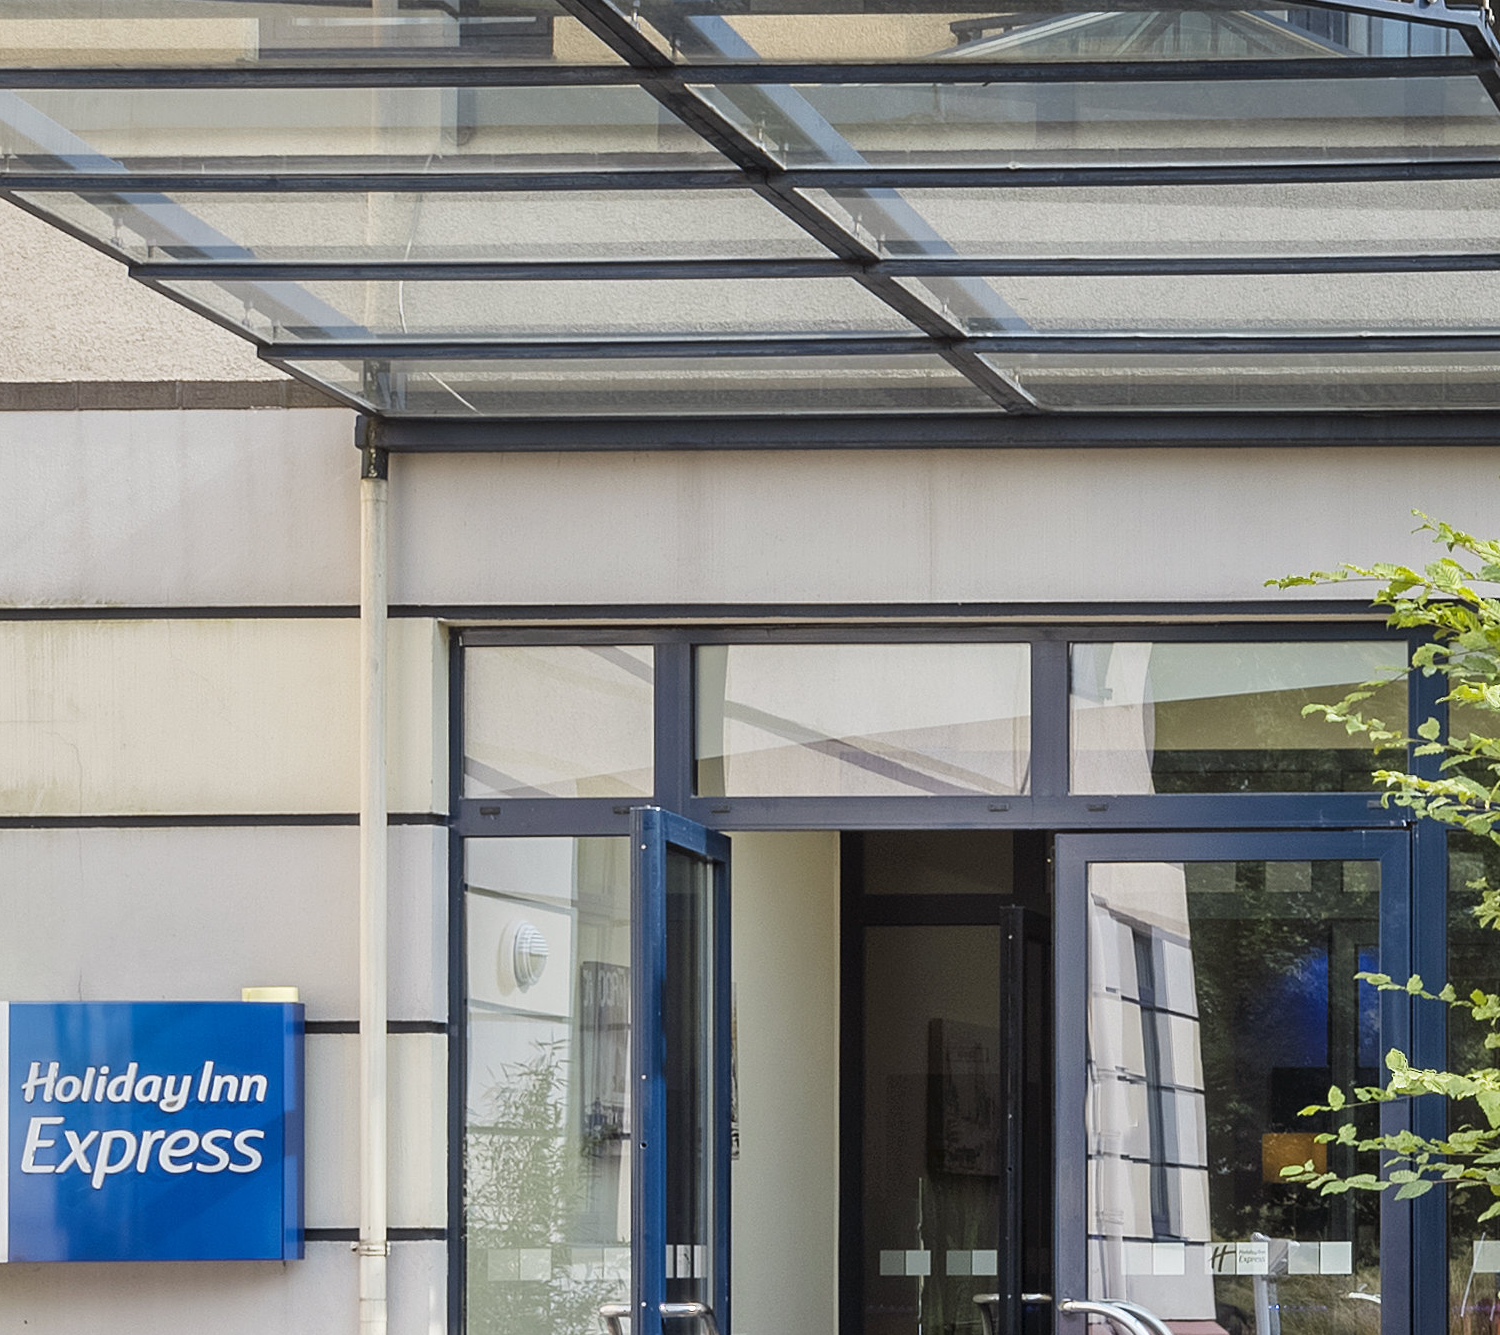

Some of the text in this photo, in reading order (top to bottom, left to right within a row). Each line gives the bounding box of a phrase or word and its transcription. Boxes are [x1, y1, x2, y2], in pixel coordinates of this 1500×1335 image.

[21, 1060, 268, 1113] Holiday Inn
[20, 1116, 265, 1190] Express
